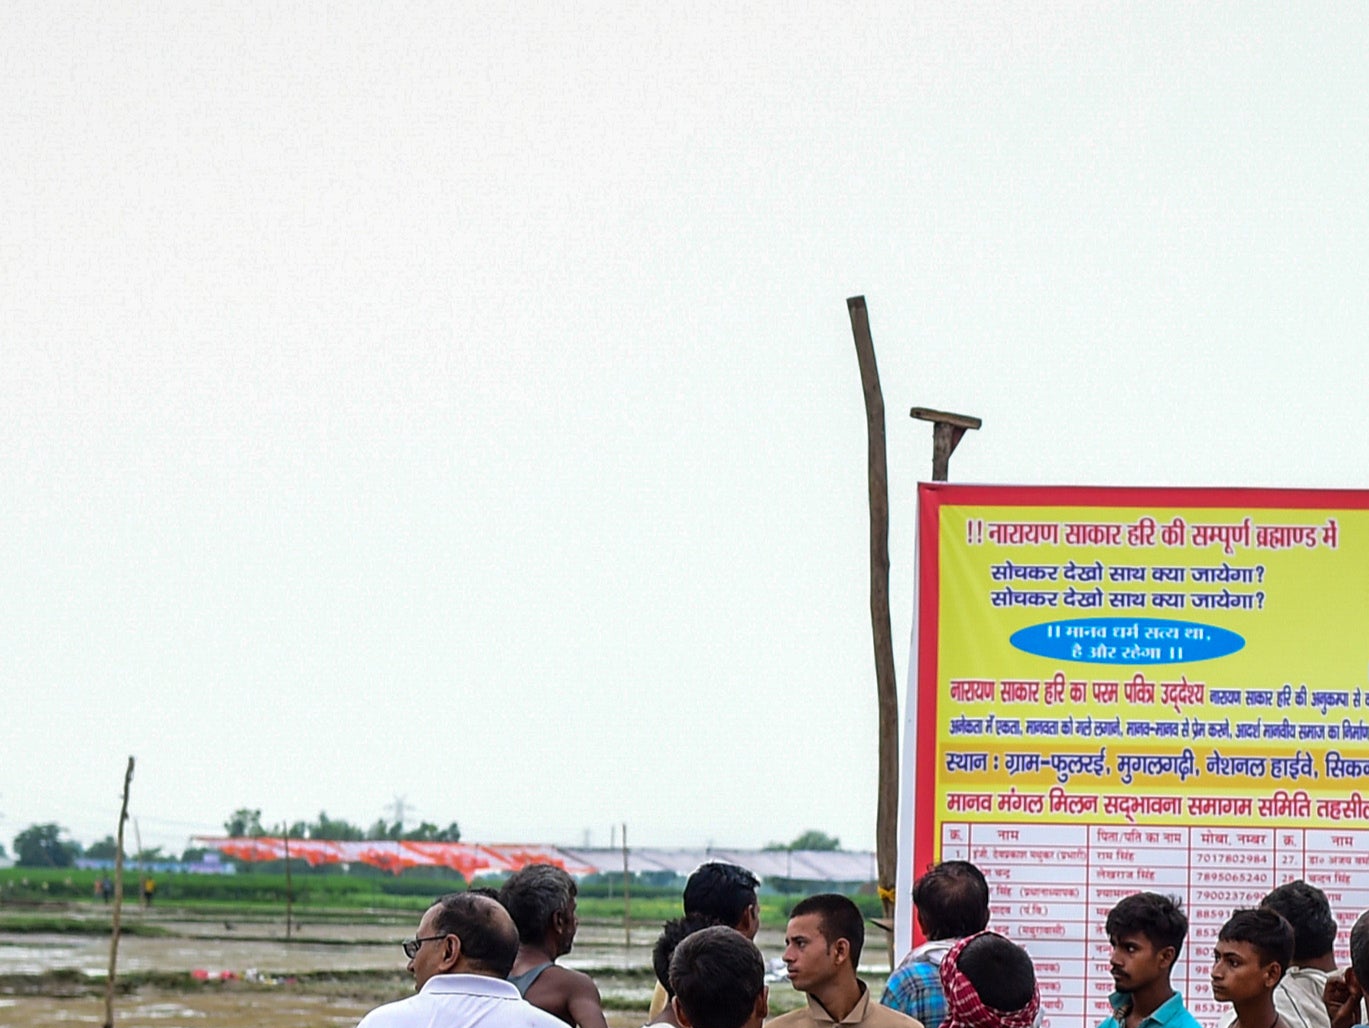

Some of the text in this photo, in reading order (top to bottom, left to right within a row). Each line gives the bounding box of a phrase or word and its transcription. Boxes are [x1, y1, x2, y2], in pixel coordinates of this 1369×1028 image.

[988, 523, 1058, 543] नारायण
[1065, 524, 1121, 544] साकार
[1127, 517, 1154, 545] हरि
[1161, 518, 1184, 545] की
[1192, 518, 1249, 553] सम्पूर्ण
[1256, 526, 1316, 548] ब्रह्माण्ड
[1322, 520, 1336, 547] में
[991, 560, 1263, 582] सोचकर देखो साथ क्या जायेगा?
[991, 586, 1263, 608] सोचकर देखो साथ क्या जायेगा?
[1065, 625, 1107, 638] मानव
[1113, 623, 1139, 639] धर्म
[1144, 626, 1180, 639] सत्य
[1072, 642, 1082, 658] है
[1089, 642, 1116, 658] और
[1121, 643, 1161, 659] रहेगा
[950, 680, 994, 701] नारायण
[1000, 681, 1039, 702] साकार
[1044, 673, 1065, 704] हरि
[1070, 682, 1086, 701] का
[1092, 682, 1118, 702] परम
[1124, 674, 1154, 702] पवित्र
[1210, 690, 1241, 704] नारायण
[1245, 690, 1272, 705] साकार
[1277, 685, 1291, 707] हरि
[1295, 685, 1306, 705] की
[1353, 687, 1360, 707] से
[1061, 716, 1072, 734] को
[946, 753, 987, 770] स्थान
[1005, 748, 1109, 782] ग्राम-फुलरई,
[1206, 750, 1266, 776] नेशनल
[1270, 752, 1317, 779] हाईवे,
[947, 794, 992, 810] मानव
[998, 788, 1044, 812] मंगल
[1049, 788, 1097, 813] मिलन
[1188, 797, 1251, 815] समागम
[1258, 792, 1310, 816] समिति
[998, 830, 1019, 841] नाम
[1097, 830, 1181, 844] पिता/पति का नाम
[1236, 833, 1266, 845] नम्बर
[1331, 836, 1353, 847] नाम
